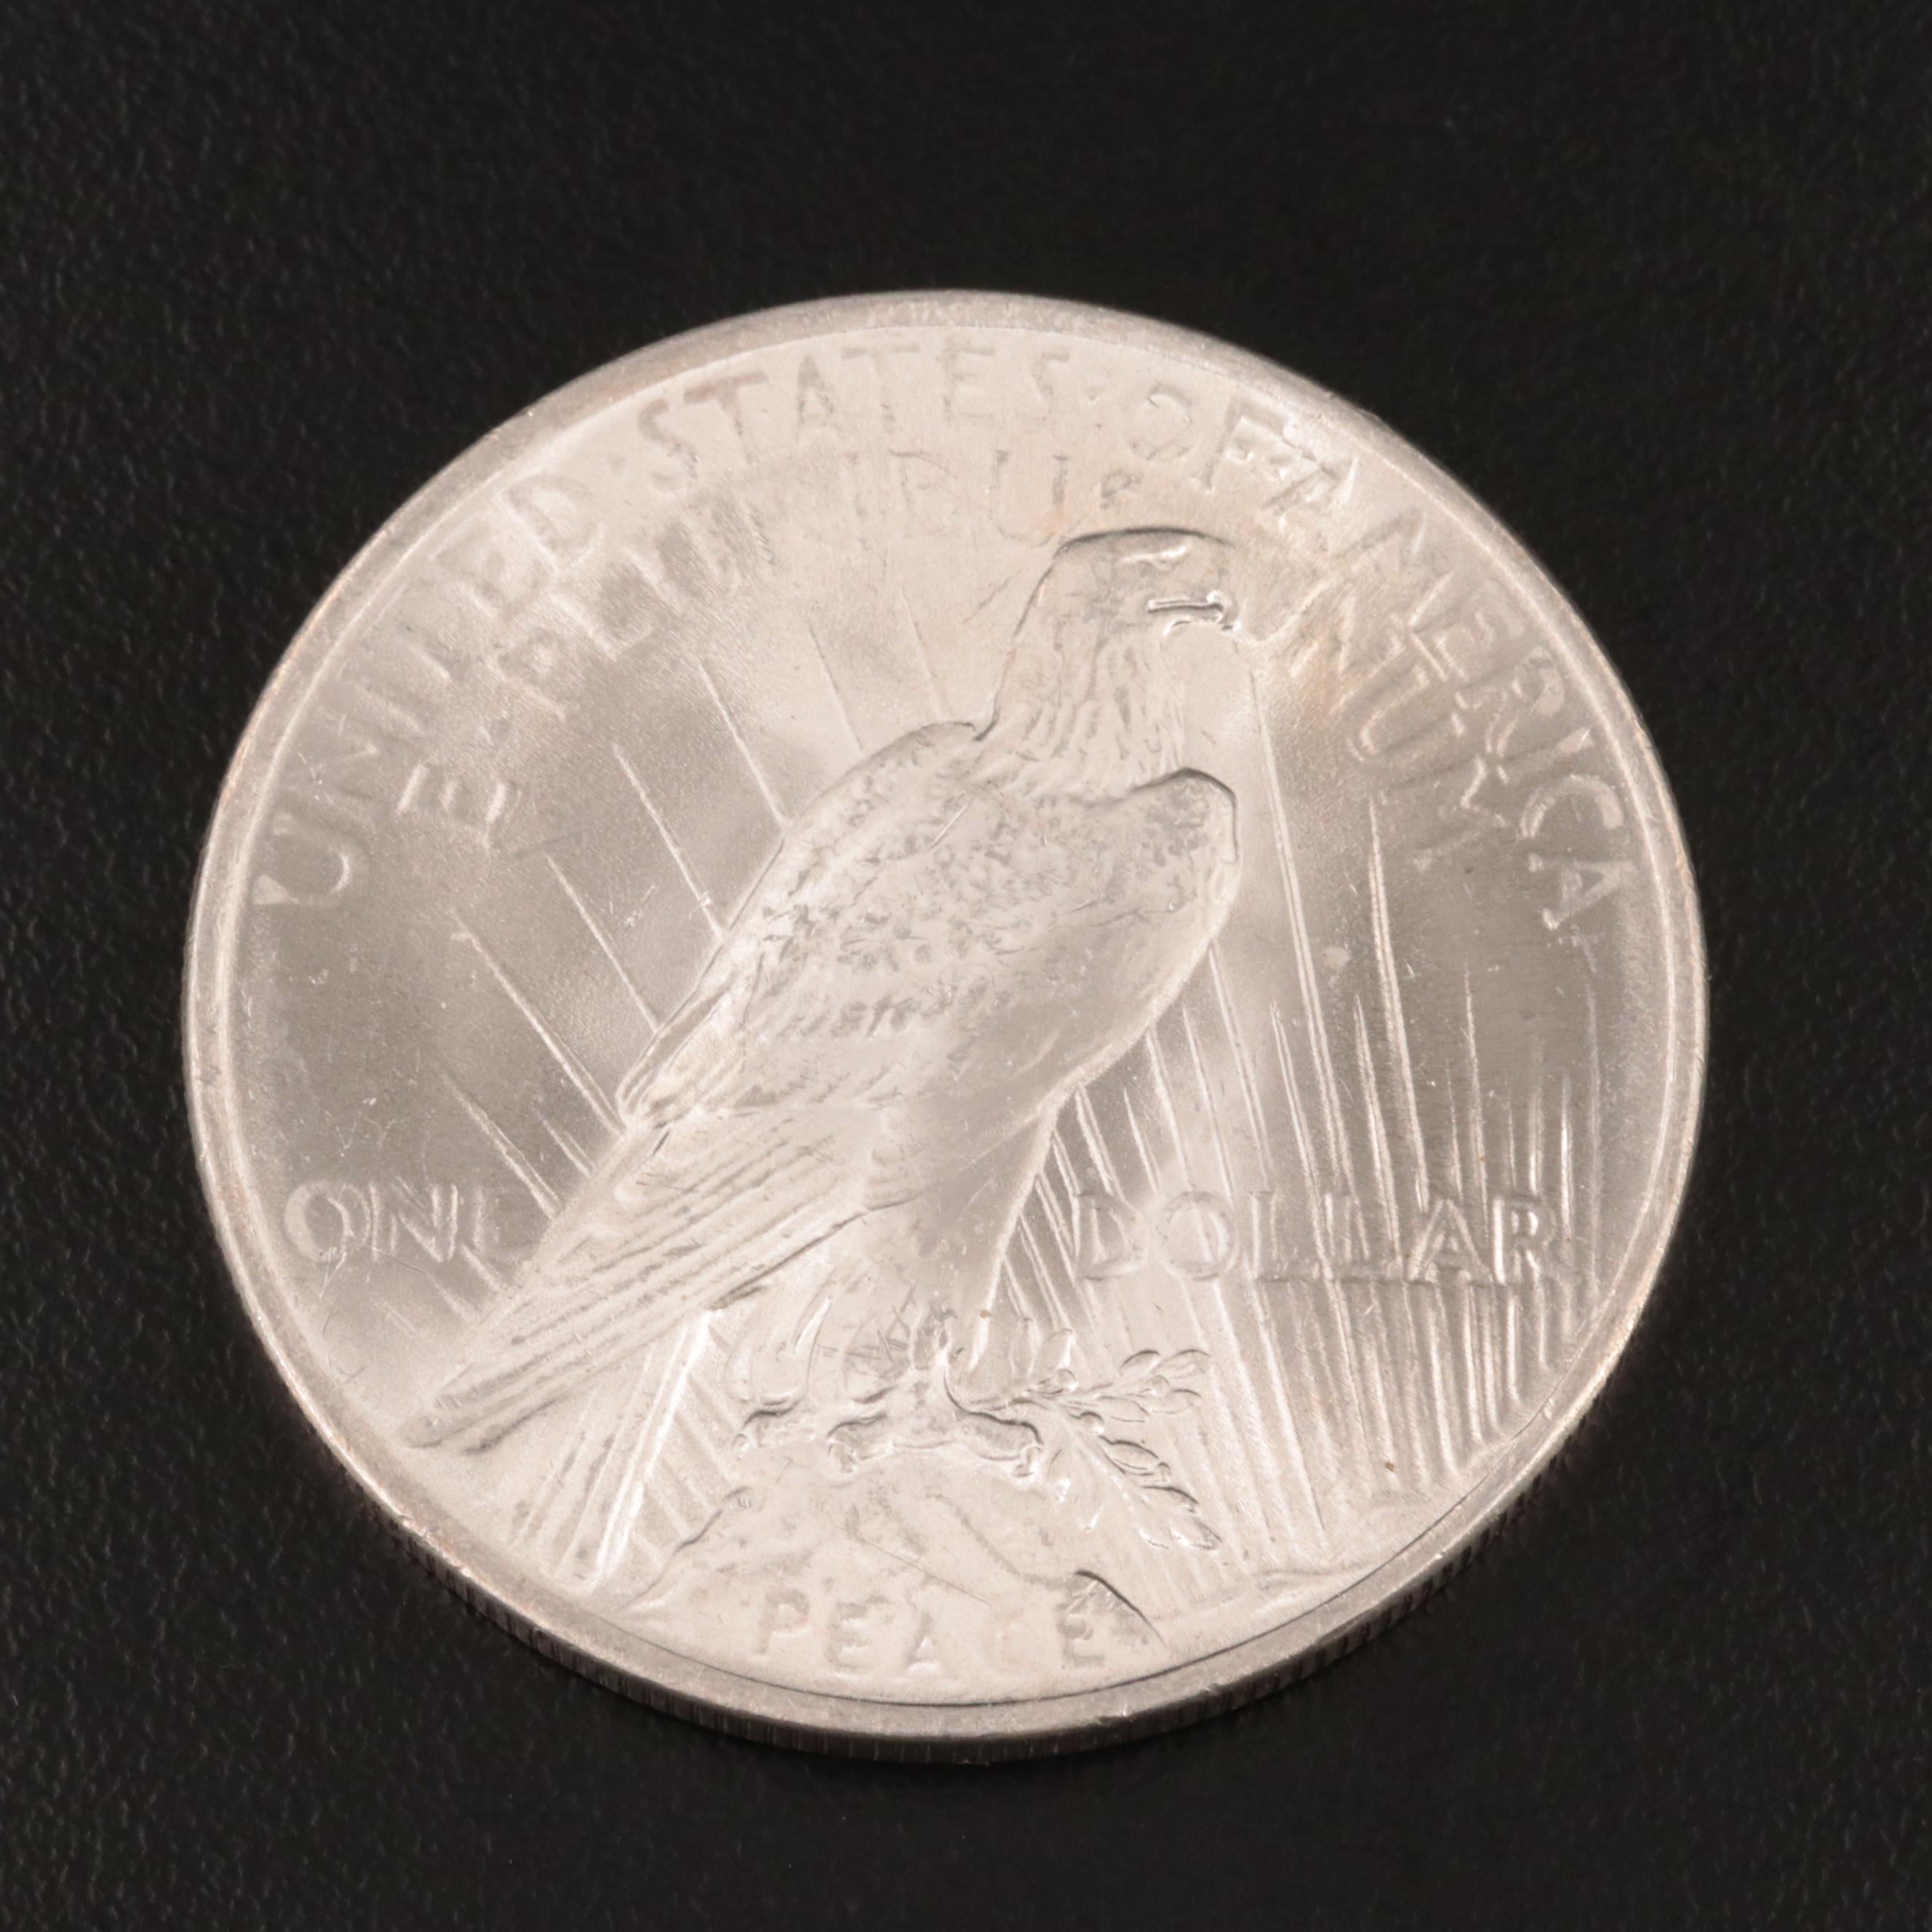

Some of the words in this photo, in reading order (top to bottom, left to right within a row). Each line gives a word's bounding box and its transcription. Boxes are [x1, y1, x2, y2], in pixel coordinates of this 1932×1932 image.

[252, 473, 605, 908] UNITED
[634, 343, 1071, 495] STATES
[1127, 381, 1289, 496] OF
[1262, 445, 1638, 933] AMERICA
[1074, 1189, 1584, 1288] DOLLAR
[754, 1587, 1107, 1676] PEACE
